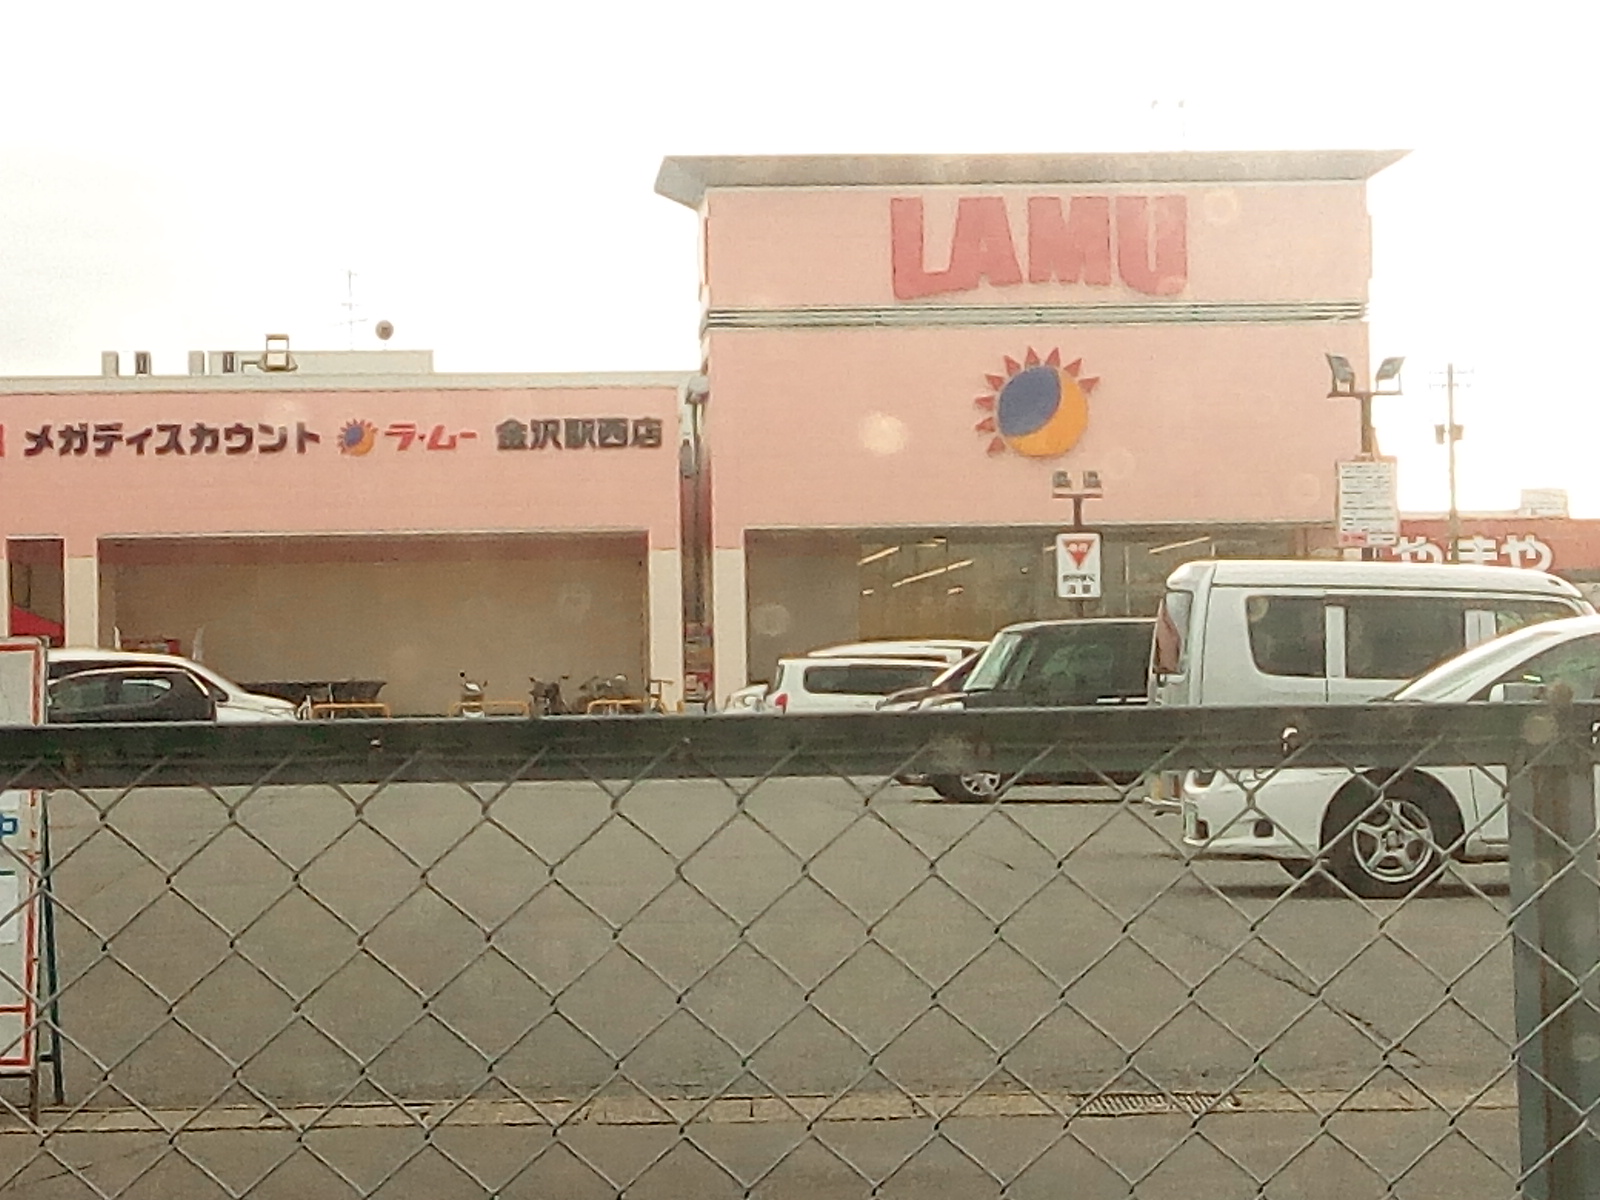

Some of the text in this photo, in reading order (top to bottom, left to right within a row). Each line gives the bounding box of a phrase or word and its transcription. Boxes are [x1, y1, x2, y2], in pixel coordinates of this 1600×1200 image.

[890, 196, 1188, 300] LAMU
[496, 418, 664, 451] 金沢駅西店
